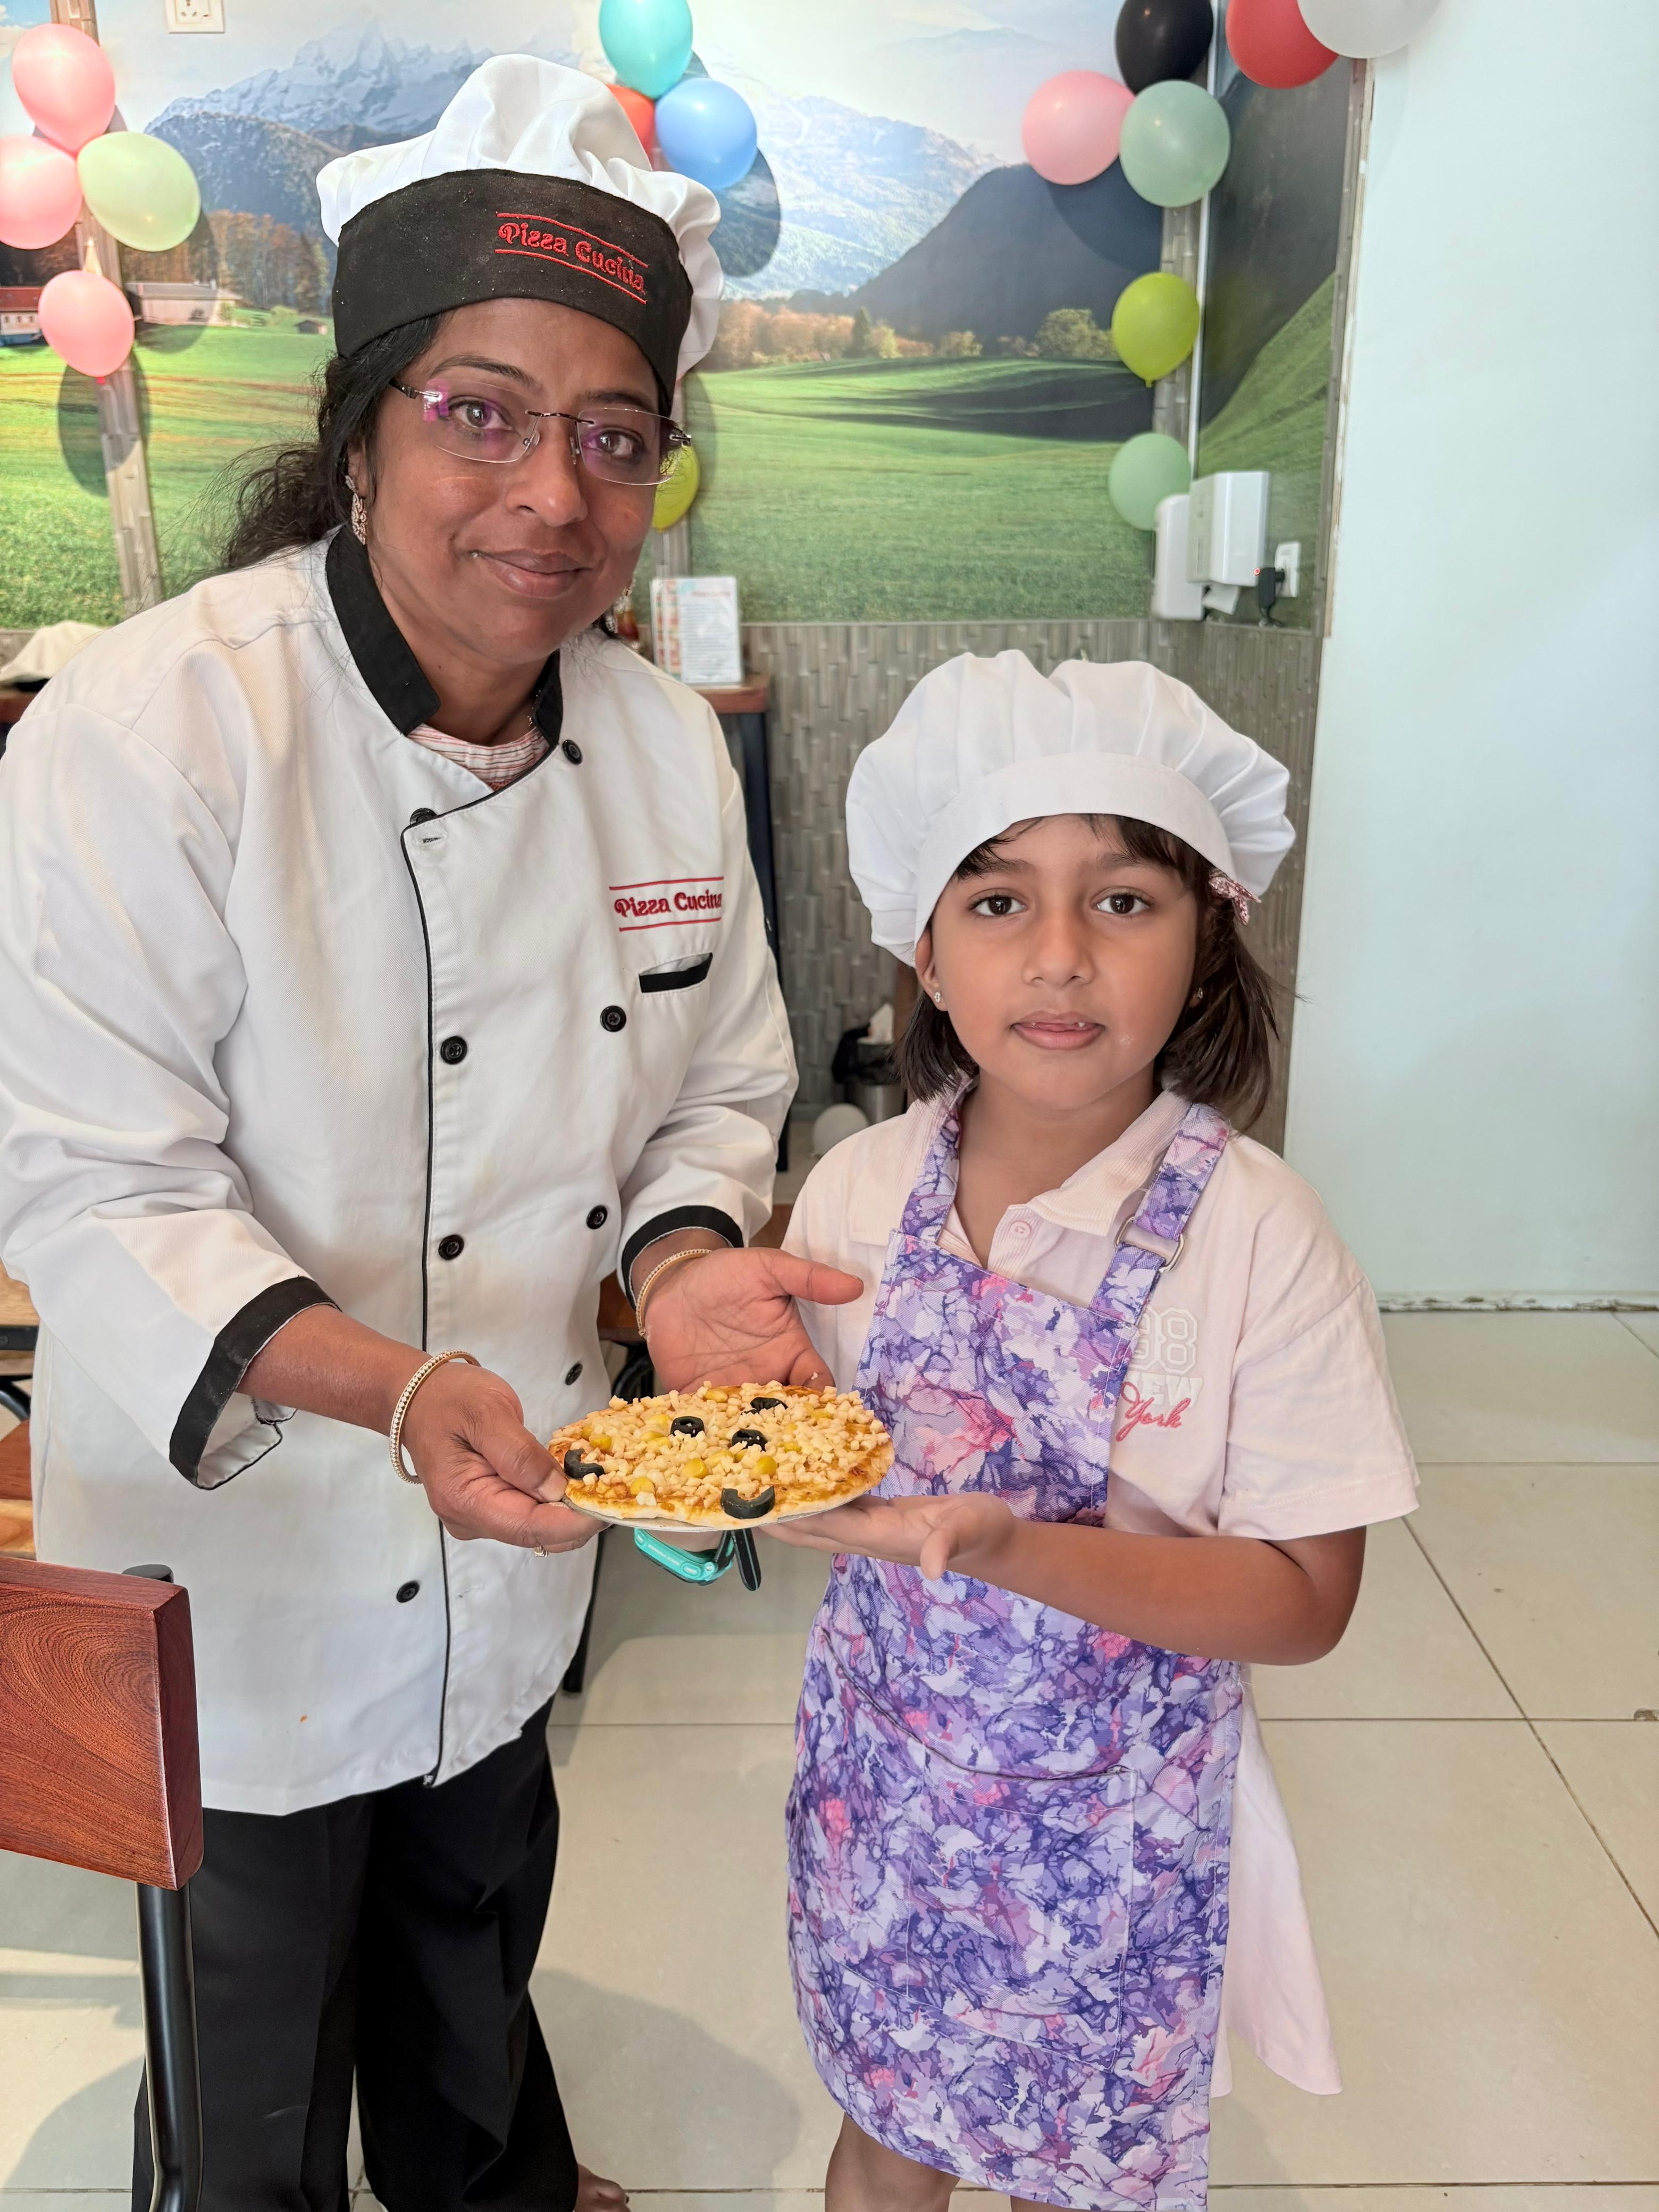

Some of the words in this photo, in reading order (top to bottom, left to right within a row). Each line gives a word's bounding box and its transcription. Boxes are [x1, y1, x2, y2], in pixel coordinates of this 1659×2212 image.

[498, 222, 569, 256] Pizza
[575, 241, 646, 296] Cucina
[614, 896, 672, 918] Pizza
[1116, 1381, 1183, 1443] York
